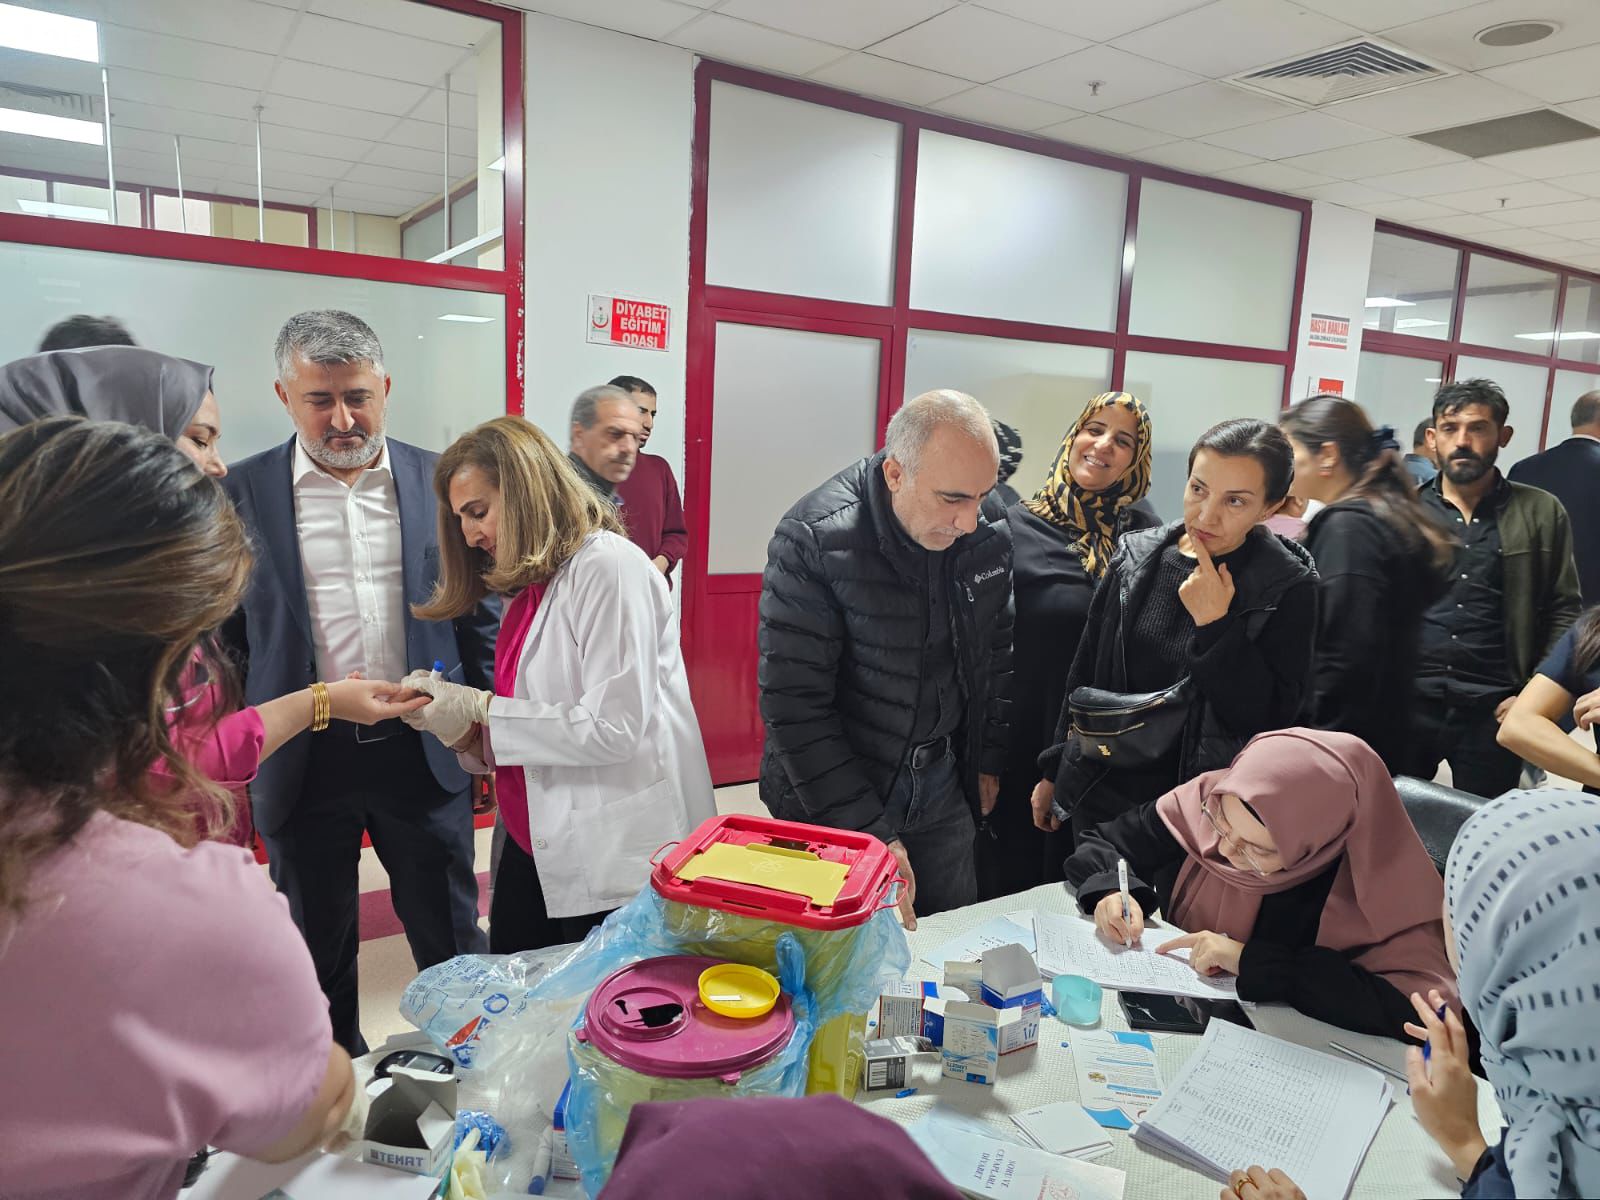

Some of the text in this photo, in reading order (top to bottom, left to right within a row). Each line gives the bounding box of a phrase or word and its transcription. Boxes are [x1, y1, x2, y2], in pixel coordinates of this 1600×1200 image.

[615, 301, 666, 320] DİYABET
[620, 316, 661, 335] EĞİTİM
[622, 332, 657, 349] ODASI
